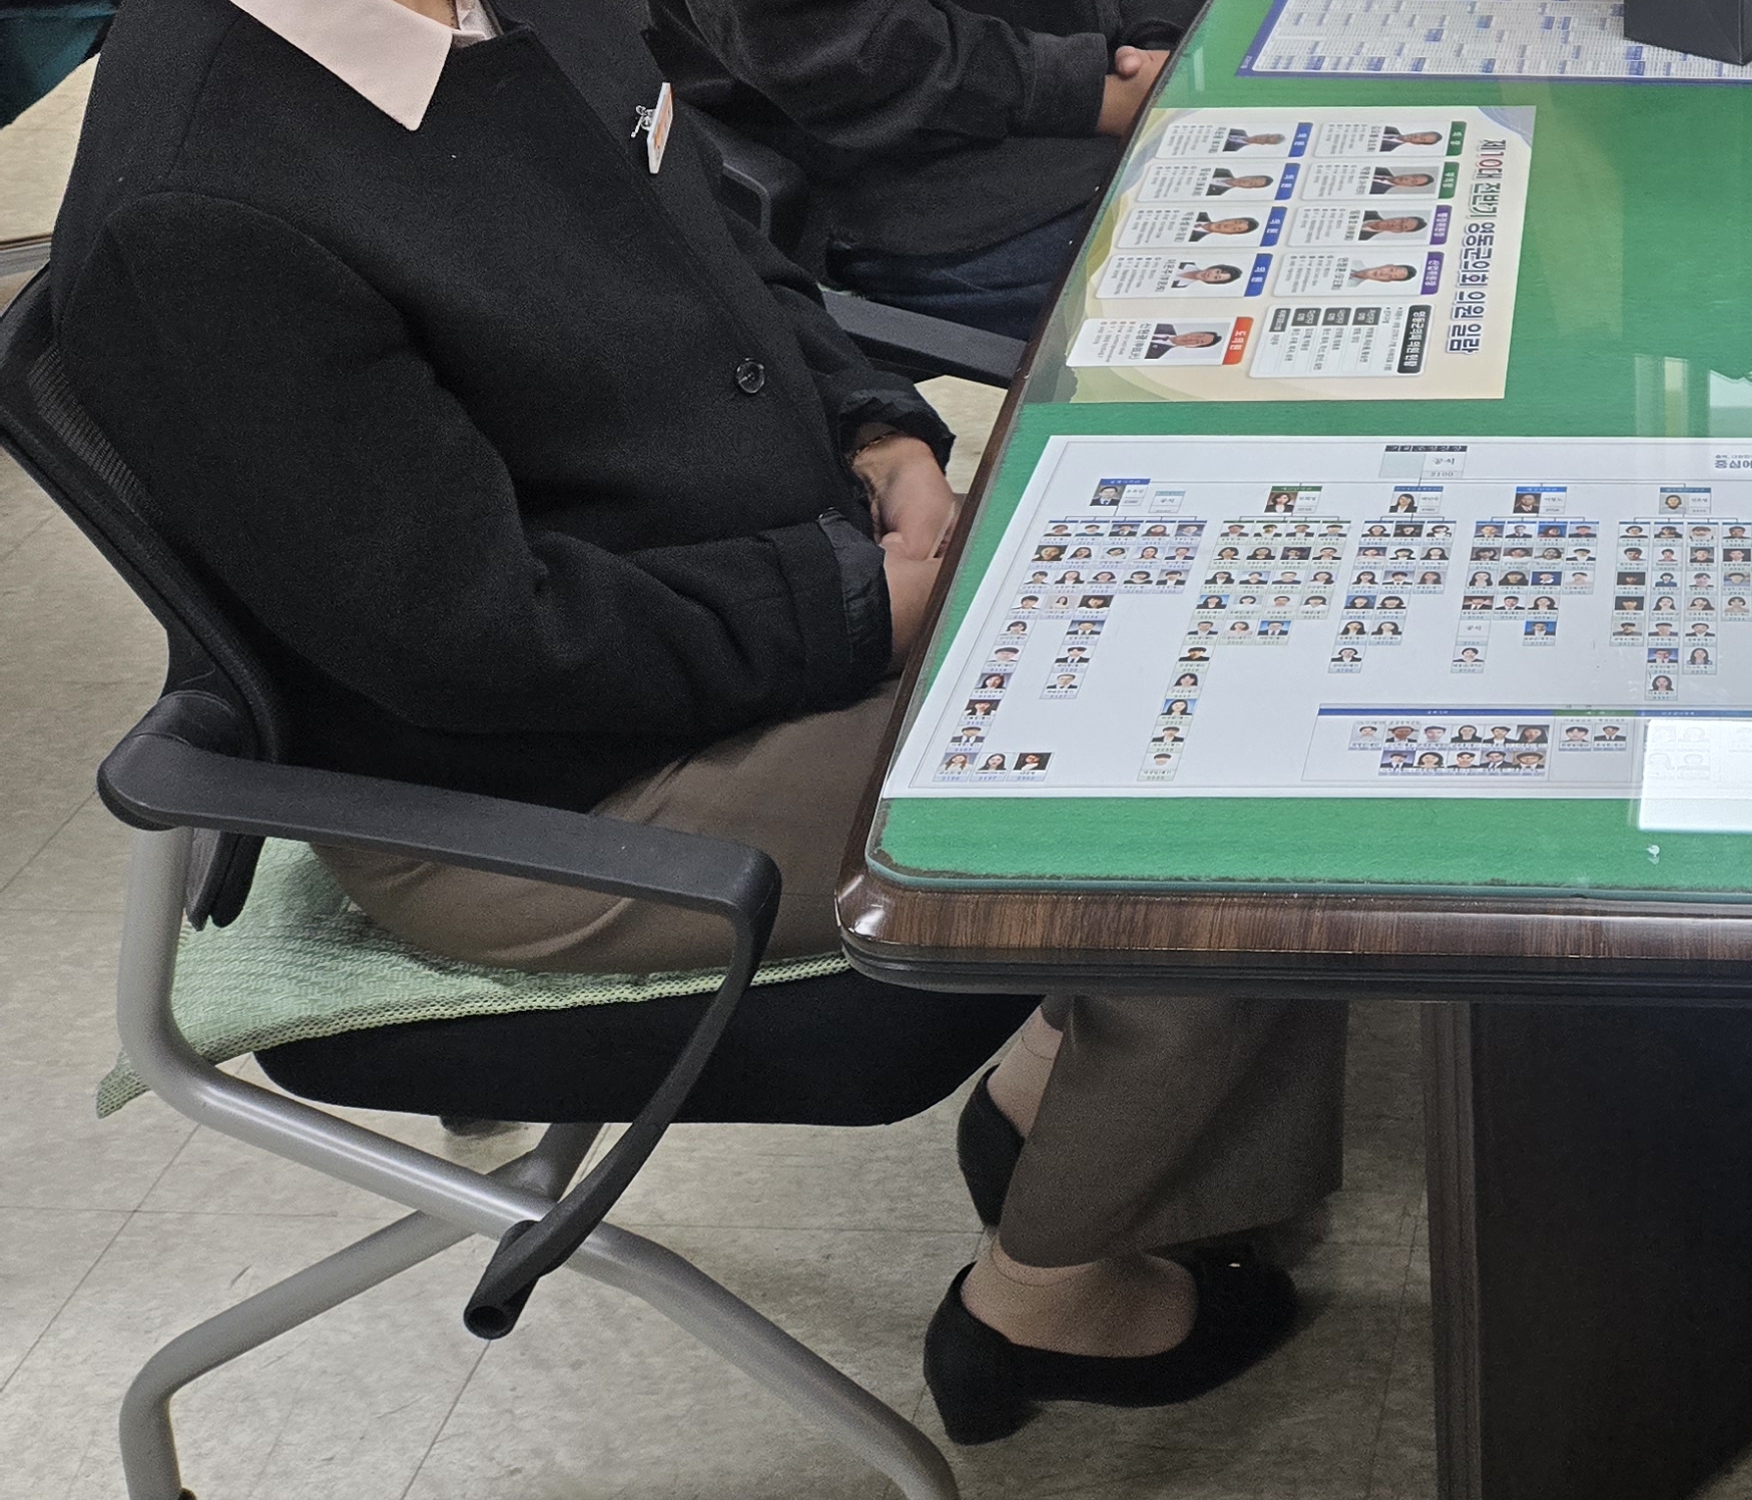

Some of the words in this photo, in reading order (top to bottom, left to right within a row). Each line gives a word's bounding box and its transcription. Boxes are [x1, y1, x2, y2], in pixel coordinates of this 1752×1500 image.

[1476, 139, 1506, 179] 제10대
[1470, 182, 1501, 218] 전반기
[1459, 221, 1495, 286] 영동군의회
[1453, 291, 1486, 319] 의원
[1229, 329, 1247, 351] 도의원
[1449, 323, 1482, 354] 일람
